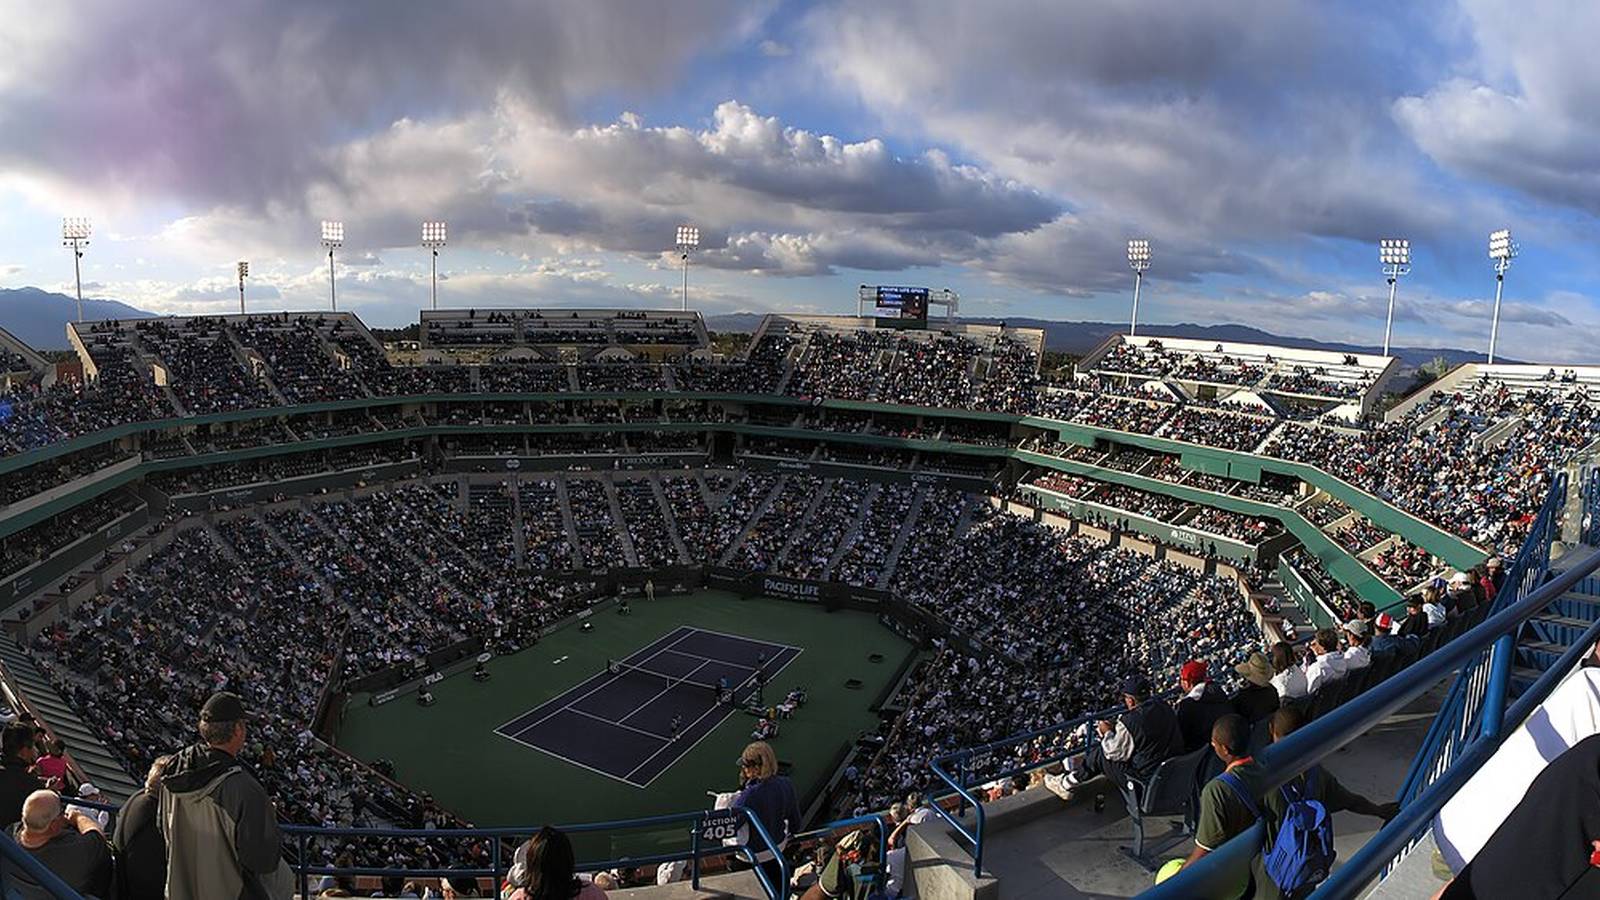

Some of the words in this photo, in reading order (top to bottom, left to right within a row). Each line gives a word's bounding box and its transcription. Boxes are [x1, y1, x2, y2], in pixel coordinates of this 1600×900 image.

[764, 578, 798, 594] PACIFIC
[799, 583, 819, 596] LIFE
[424, 672, 444, 685] FILA
[702, 816, 737, 827] SECTION
[703, 824, 736, 840] 405
